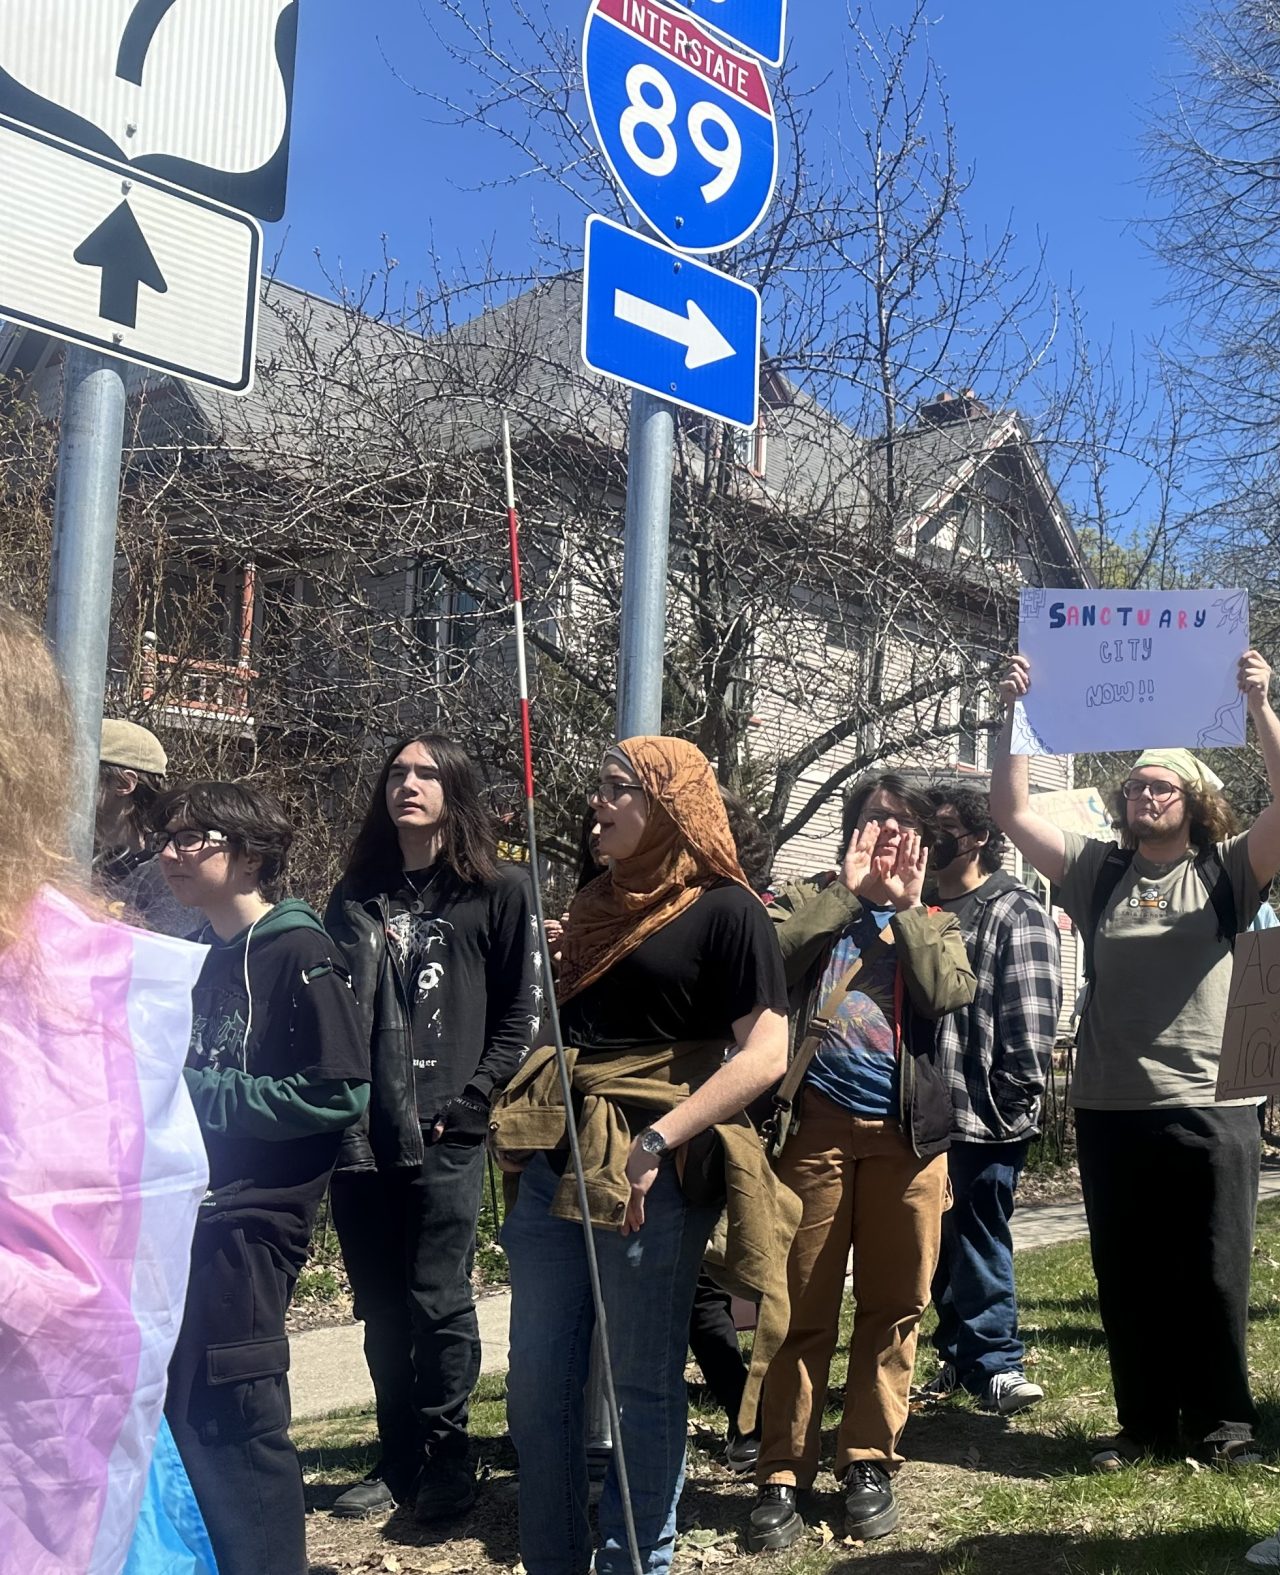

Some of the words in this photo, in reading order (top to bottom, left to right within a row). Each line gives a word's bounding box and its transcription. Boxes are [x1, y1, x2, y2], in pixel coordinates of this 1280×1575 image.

[622, 0, 750, 97] INTERSTATE
[619, 63, 742, 204] 89
[1049, 602, 1206, 629] SANCTUARY
[1100, 637, 1152, 663] CITY
